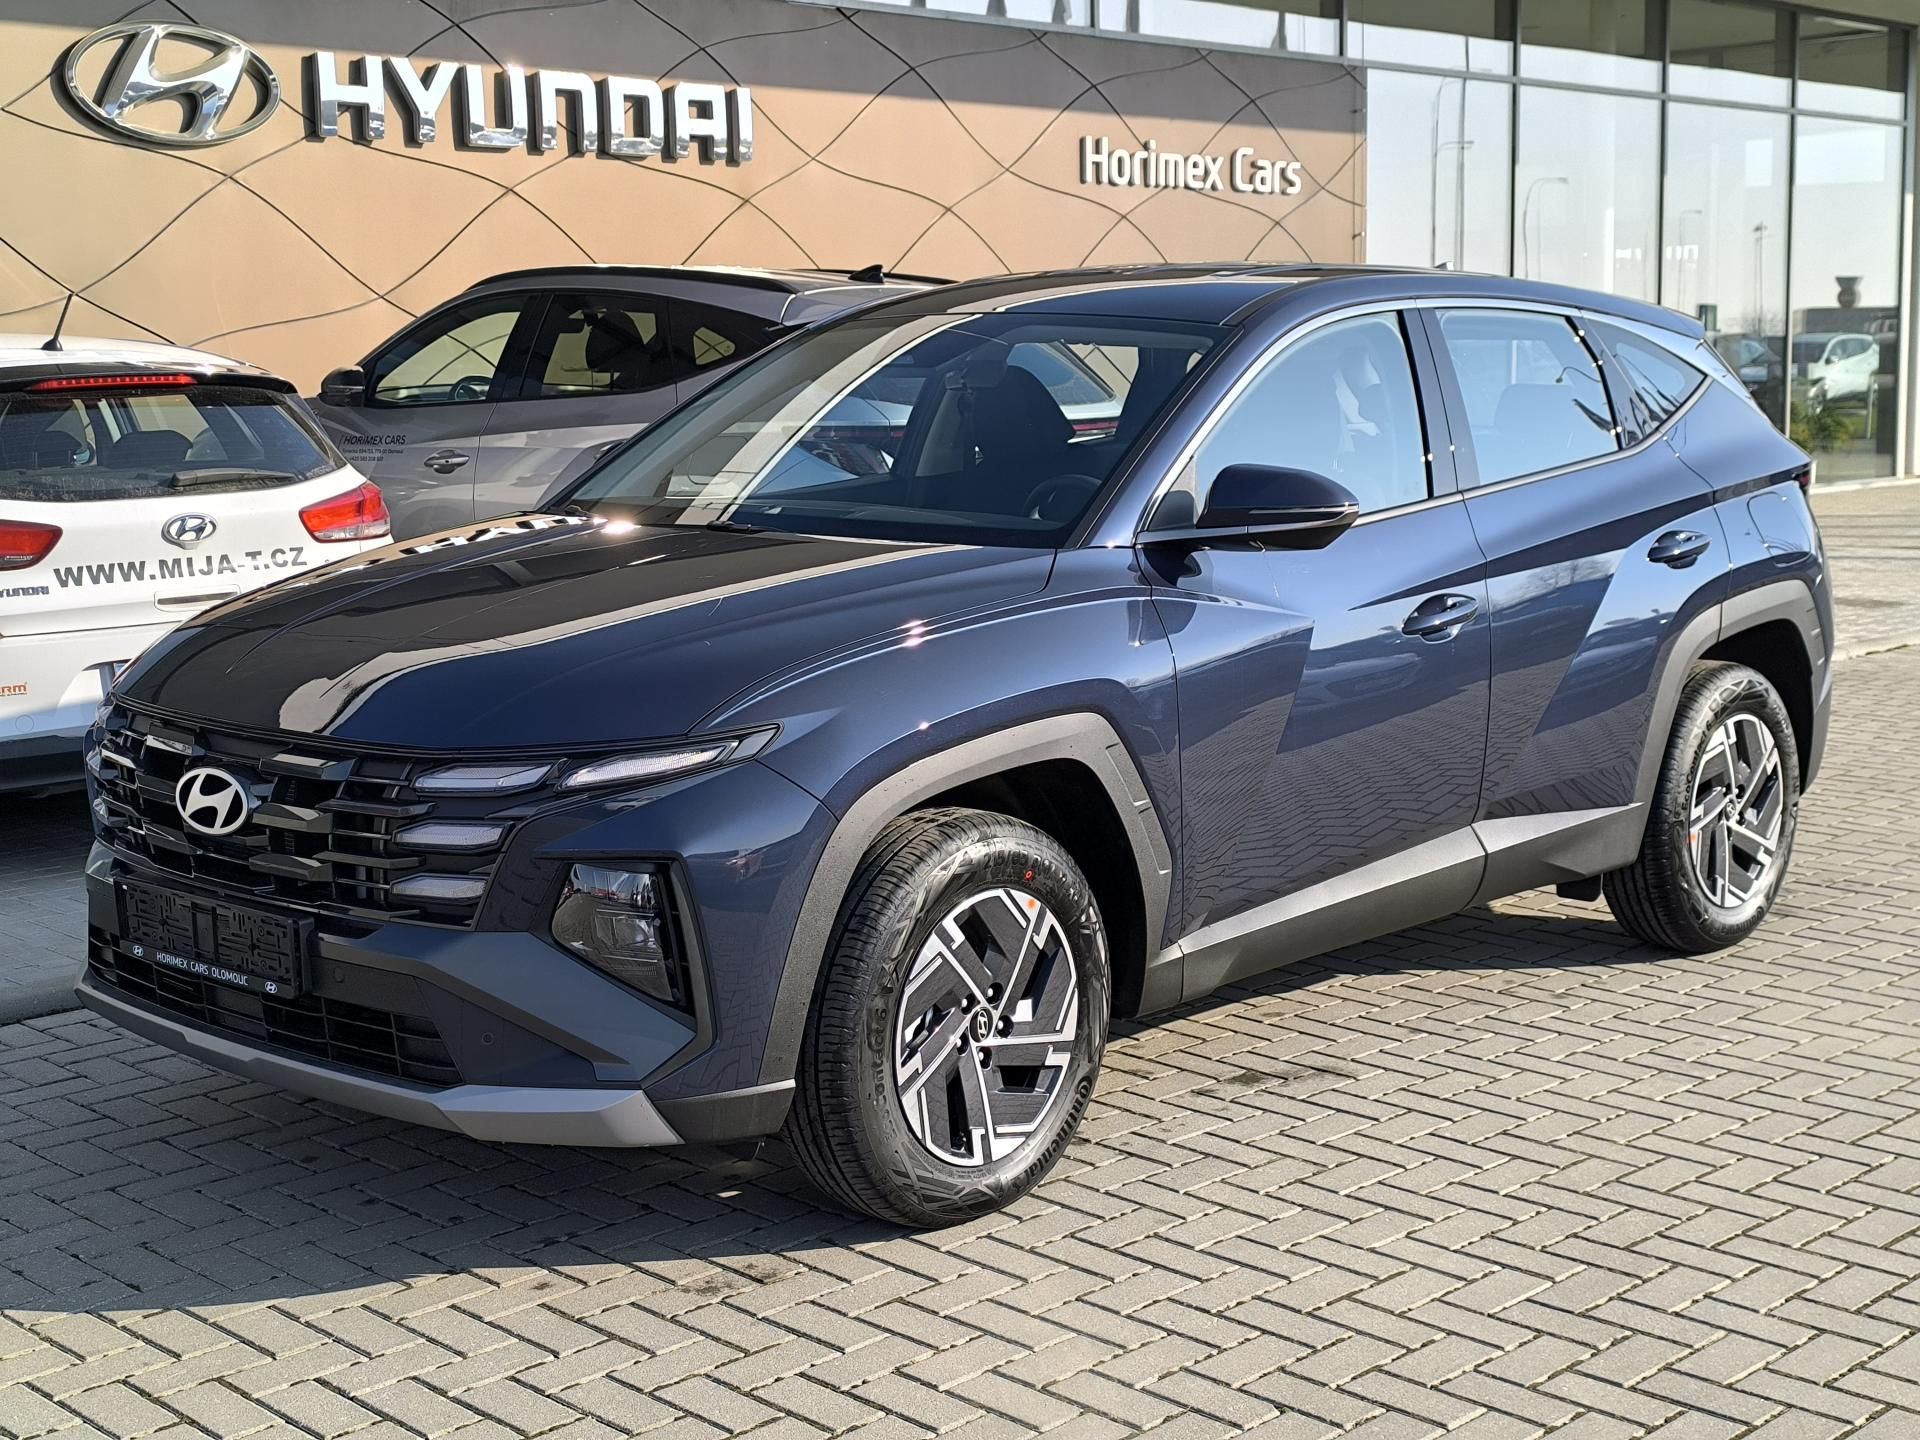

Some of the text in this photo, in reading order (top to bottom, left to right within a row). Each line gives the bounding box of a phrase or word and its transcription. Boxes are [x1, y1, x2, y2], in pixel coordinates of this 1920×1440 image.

[304, 50, 753, 163] HYUNDAI
[1080, 135, 1302, 196] Horimex Cars
[343, 434, 407, 446] HORIMEX CARS
[53, 546, 307, 588] WWW.MIJA-T.CZ
[156, 951, 249, 986] HORIMEX CARS OLOMOUC
